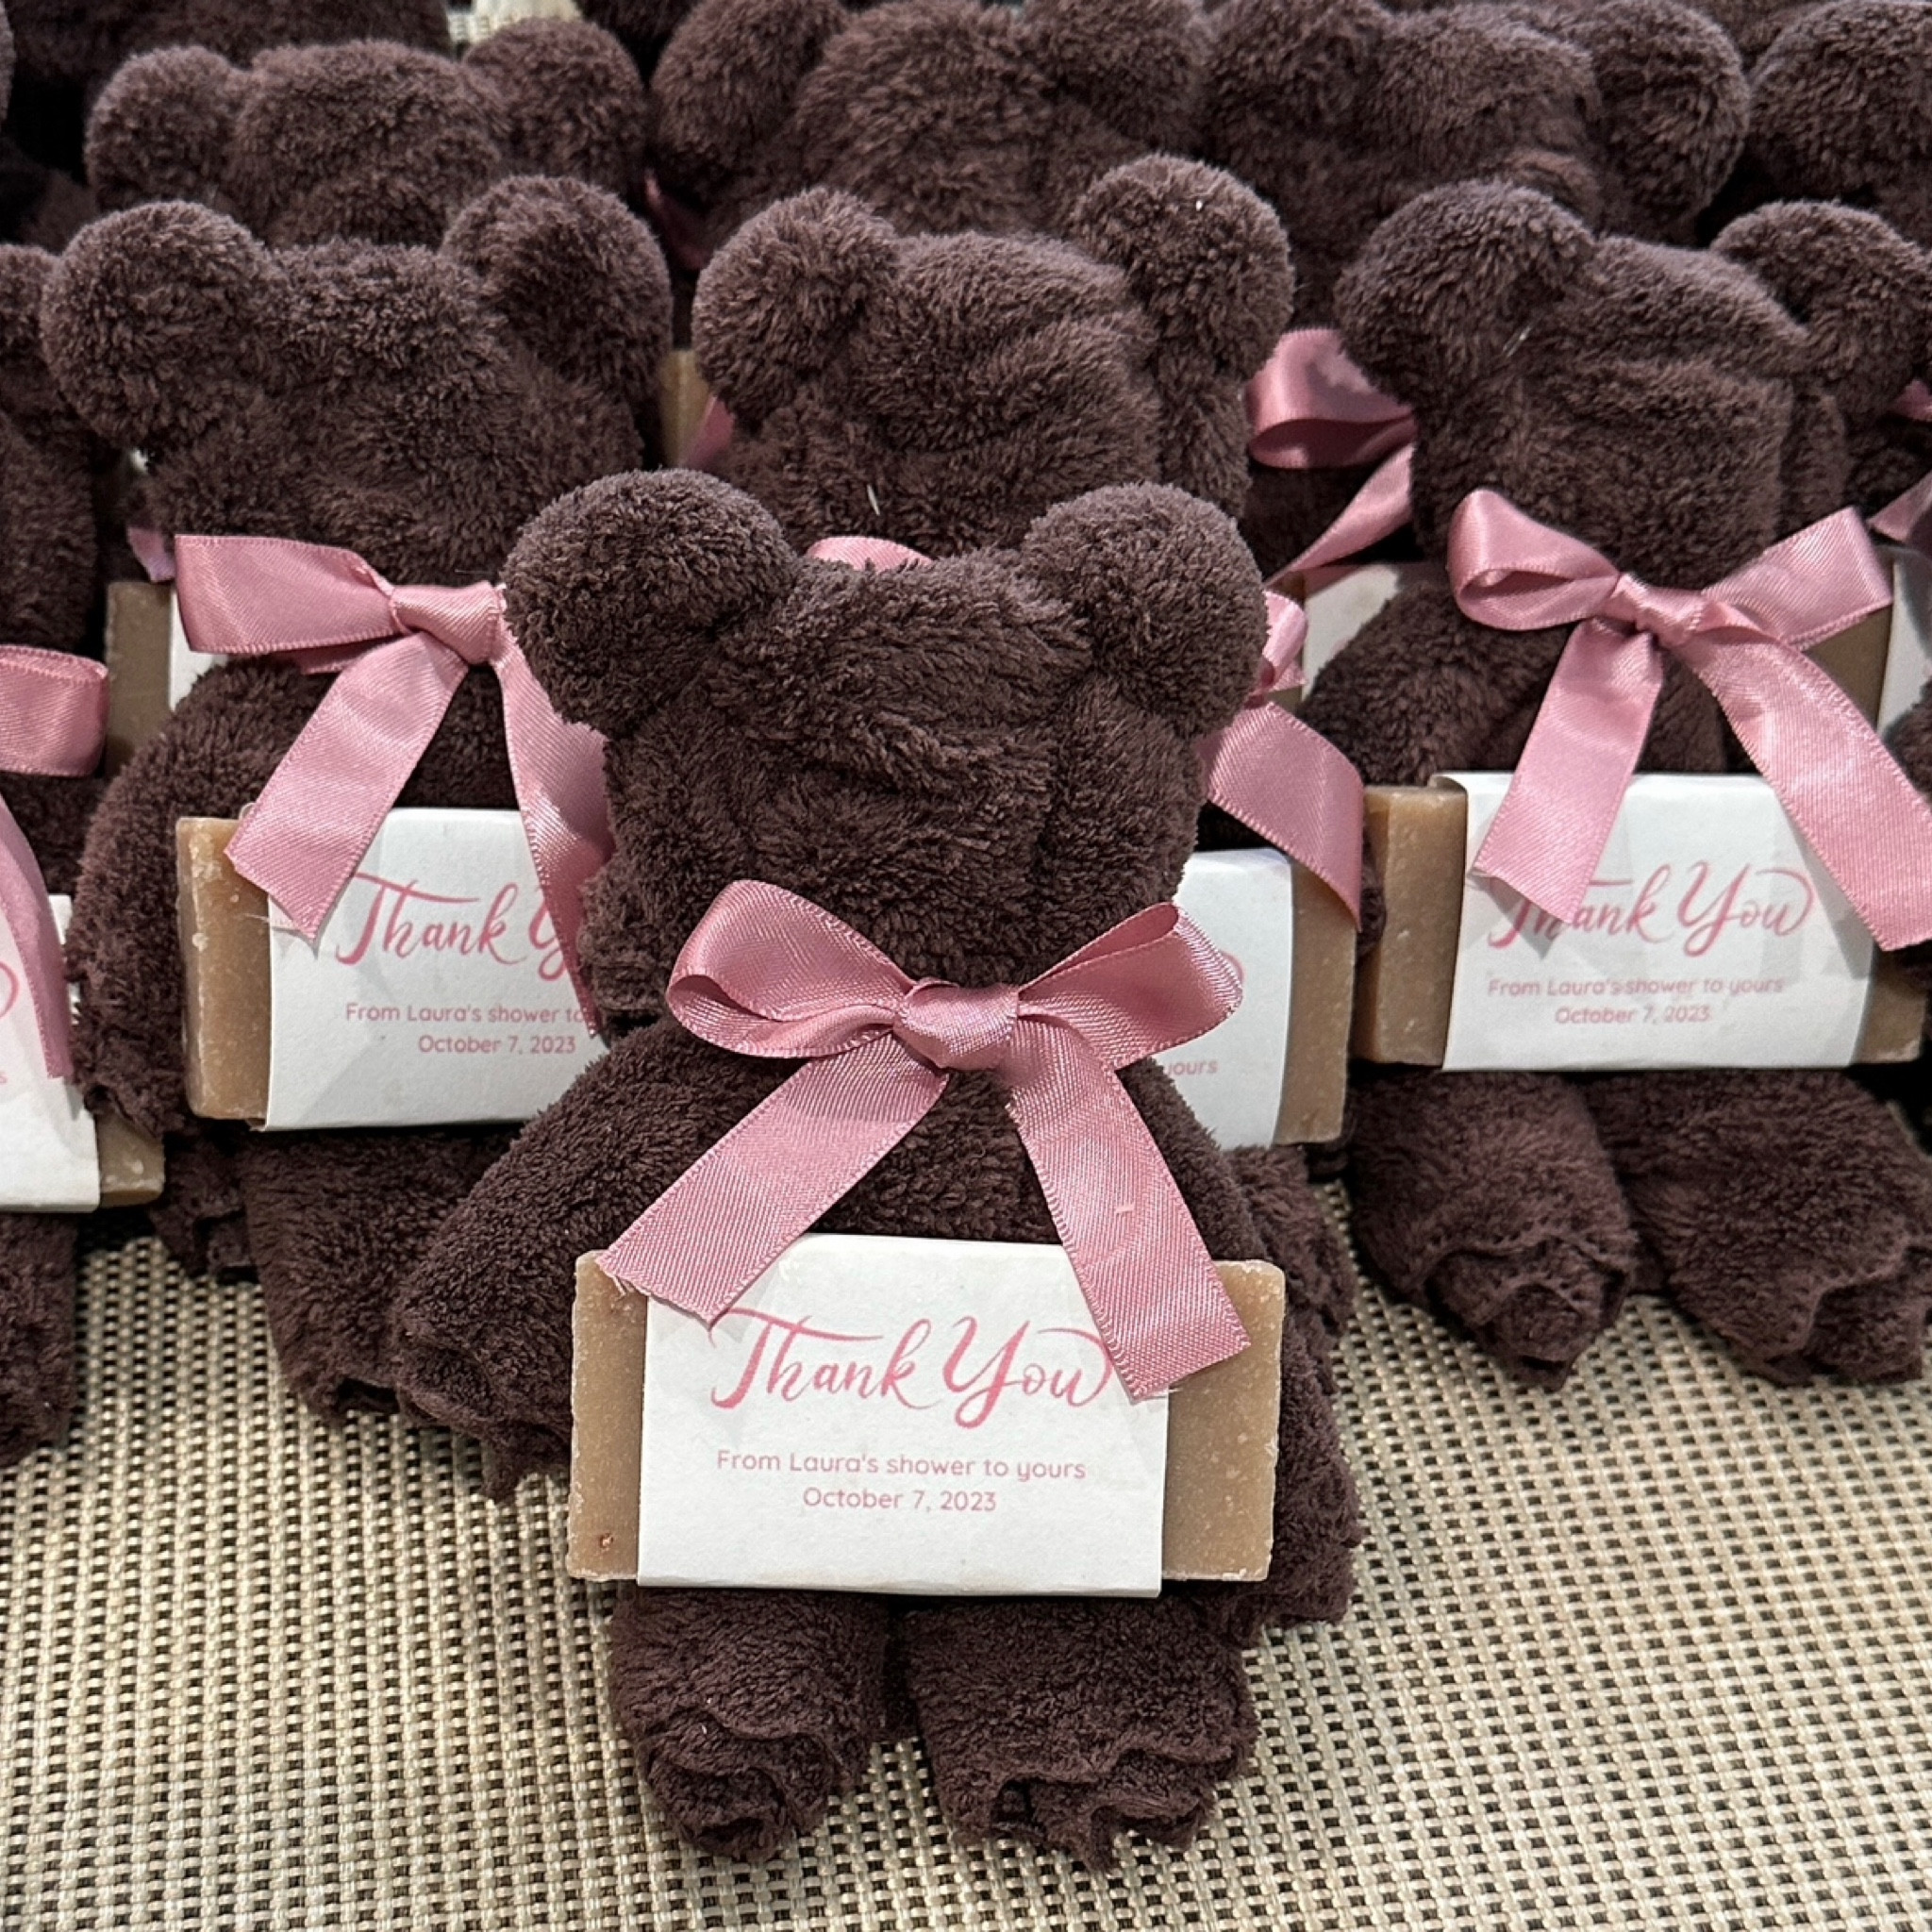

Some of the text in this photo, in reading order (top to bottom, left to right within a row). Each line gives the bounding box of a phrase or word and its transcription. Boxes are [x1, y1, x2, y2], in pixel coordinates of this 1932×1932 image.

[336, 872, 530, 965] Thank
[1677, 860, 1814, 957] You
[1488, 977, 1785, 997] From Laura's shower to yours
[345, 1003, 400, 1023] From
[408, 1004, 482, 1023] Laura's
[488, 1003, 558, 1024] shower
[1555, 1005, 1711, 1025] October 7, 2023
[418, 1034, 576, 1056] October 7, 2023
[708, 1307, 1113, 1429] Thank You
[717, 1450, 1087, 1483] From Laura's shower to yours
[803, 1487, 998, 1513] October 7, 2023
